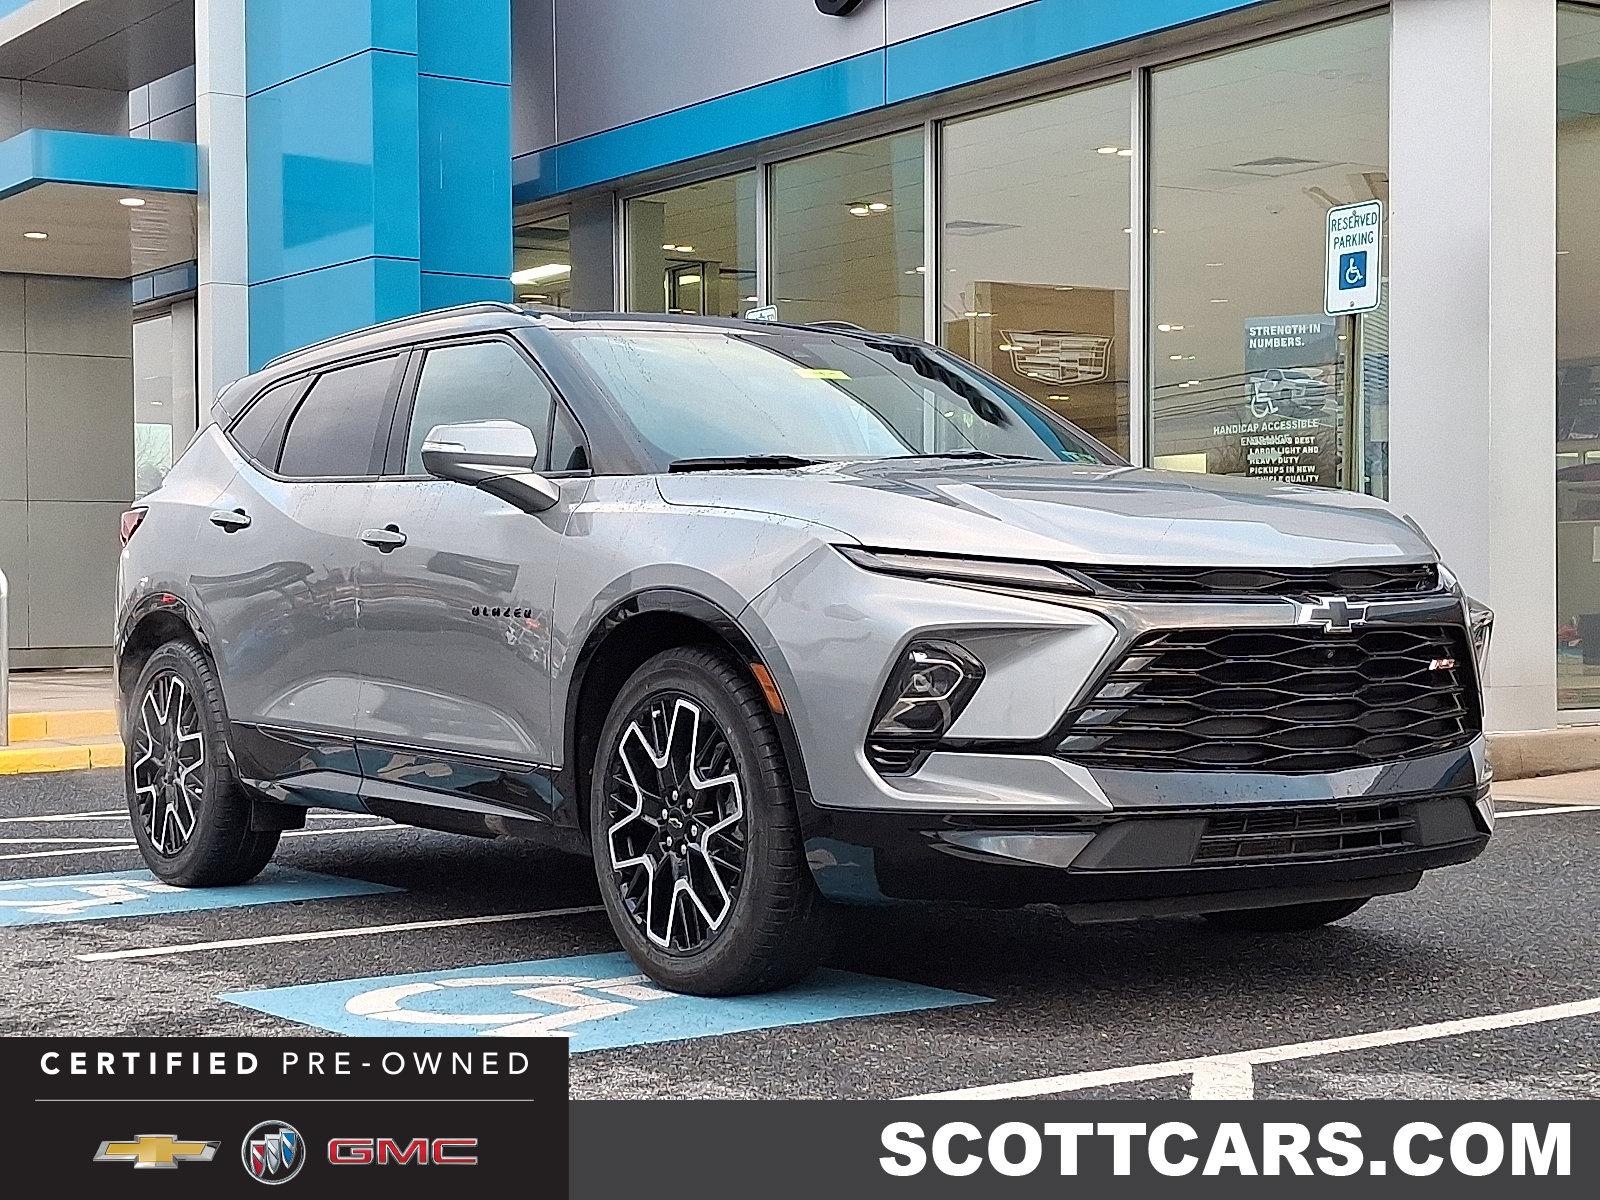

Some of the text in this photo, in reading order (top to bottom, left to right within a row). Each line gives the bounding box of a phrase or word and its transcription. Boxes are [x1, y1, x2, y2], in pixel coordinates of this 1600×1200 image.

[1331, 212, 1378, 232] RESERVED
[1333, 231, 1374, 250] PARKING
[1249, 323, 1321, 336] STRENGTH IN
[1249, 337, 1305, 349] NUMBERS.
[1213, 419, 1319, 435] HANDICAP ACCESSIBLE
[1278, 446, 1301, 455] LIGHT
[1278, 456, 1299, 464] DUTY
[1250, 466, 1284, 474] PICKUPS
[1296, 465, 1316, 473] NEW
[1285, 475, 1320, 483] QUALITY
